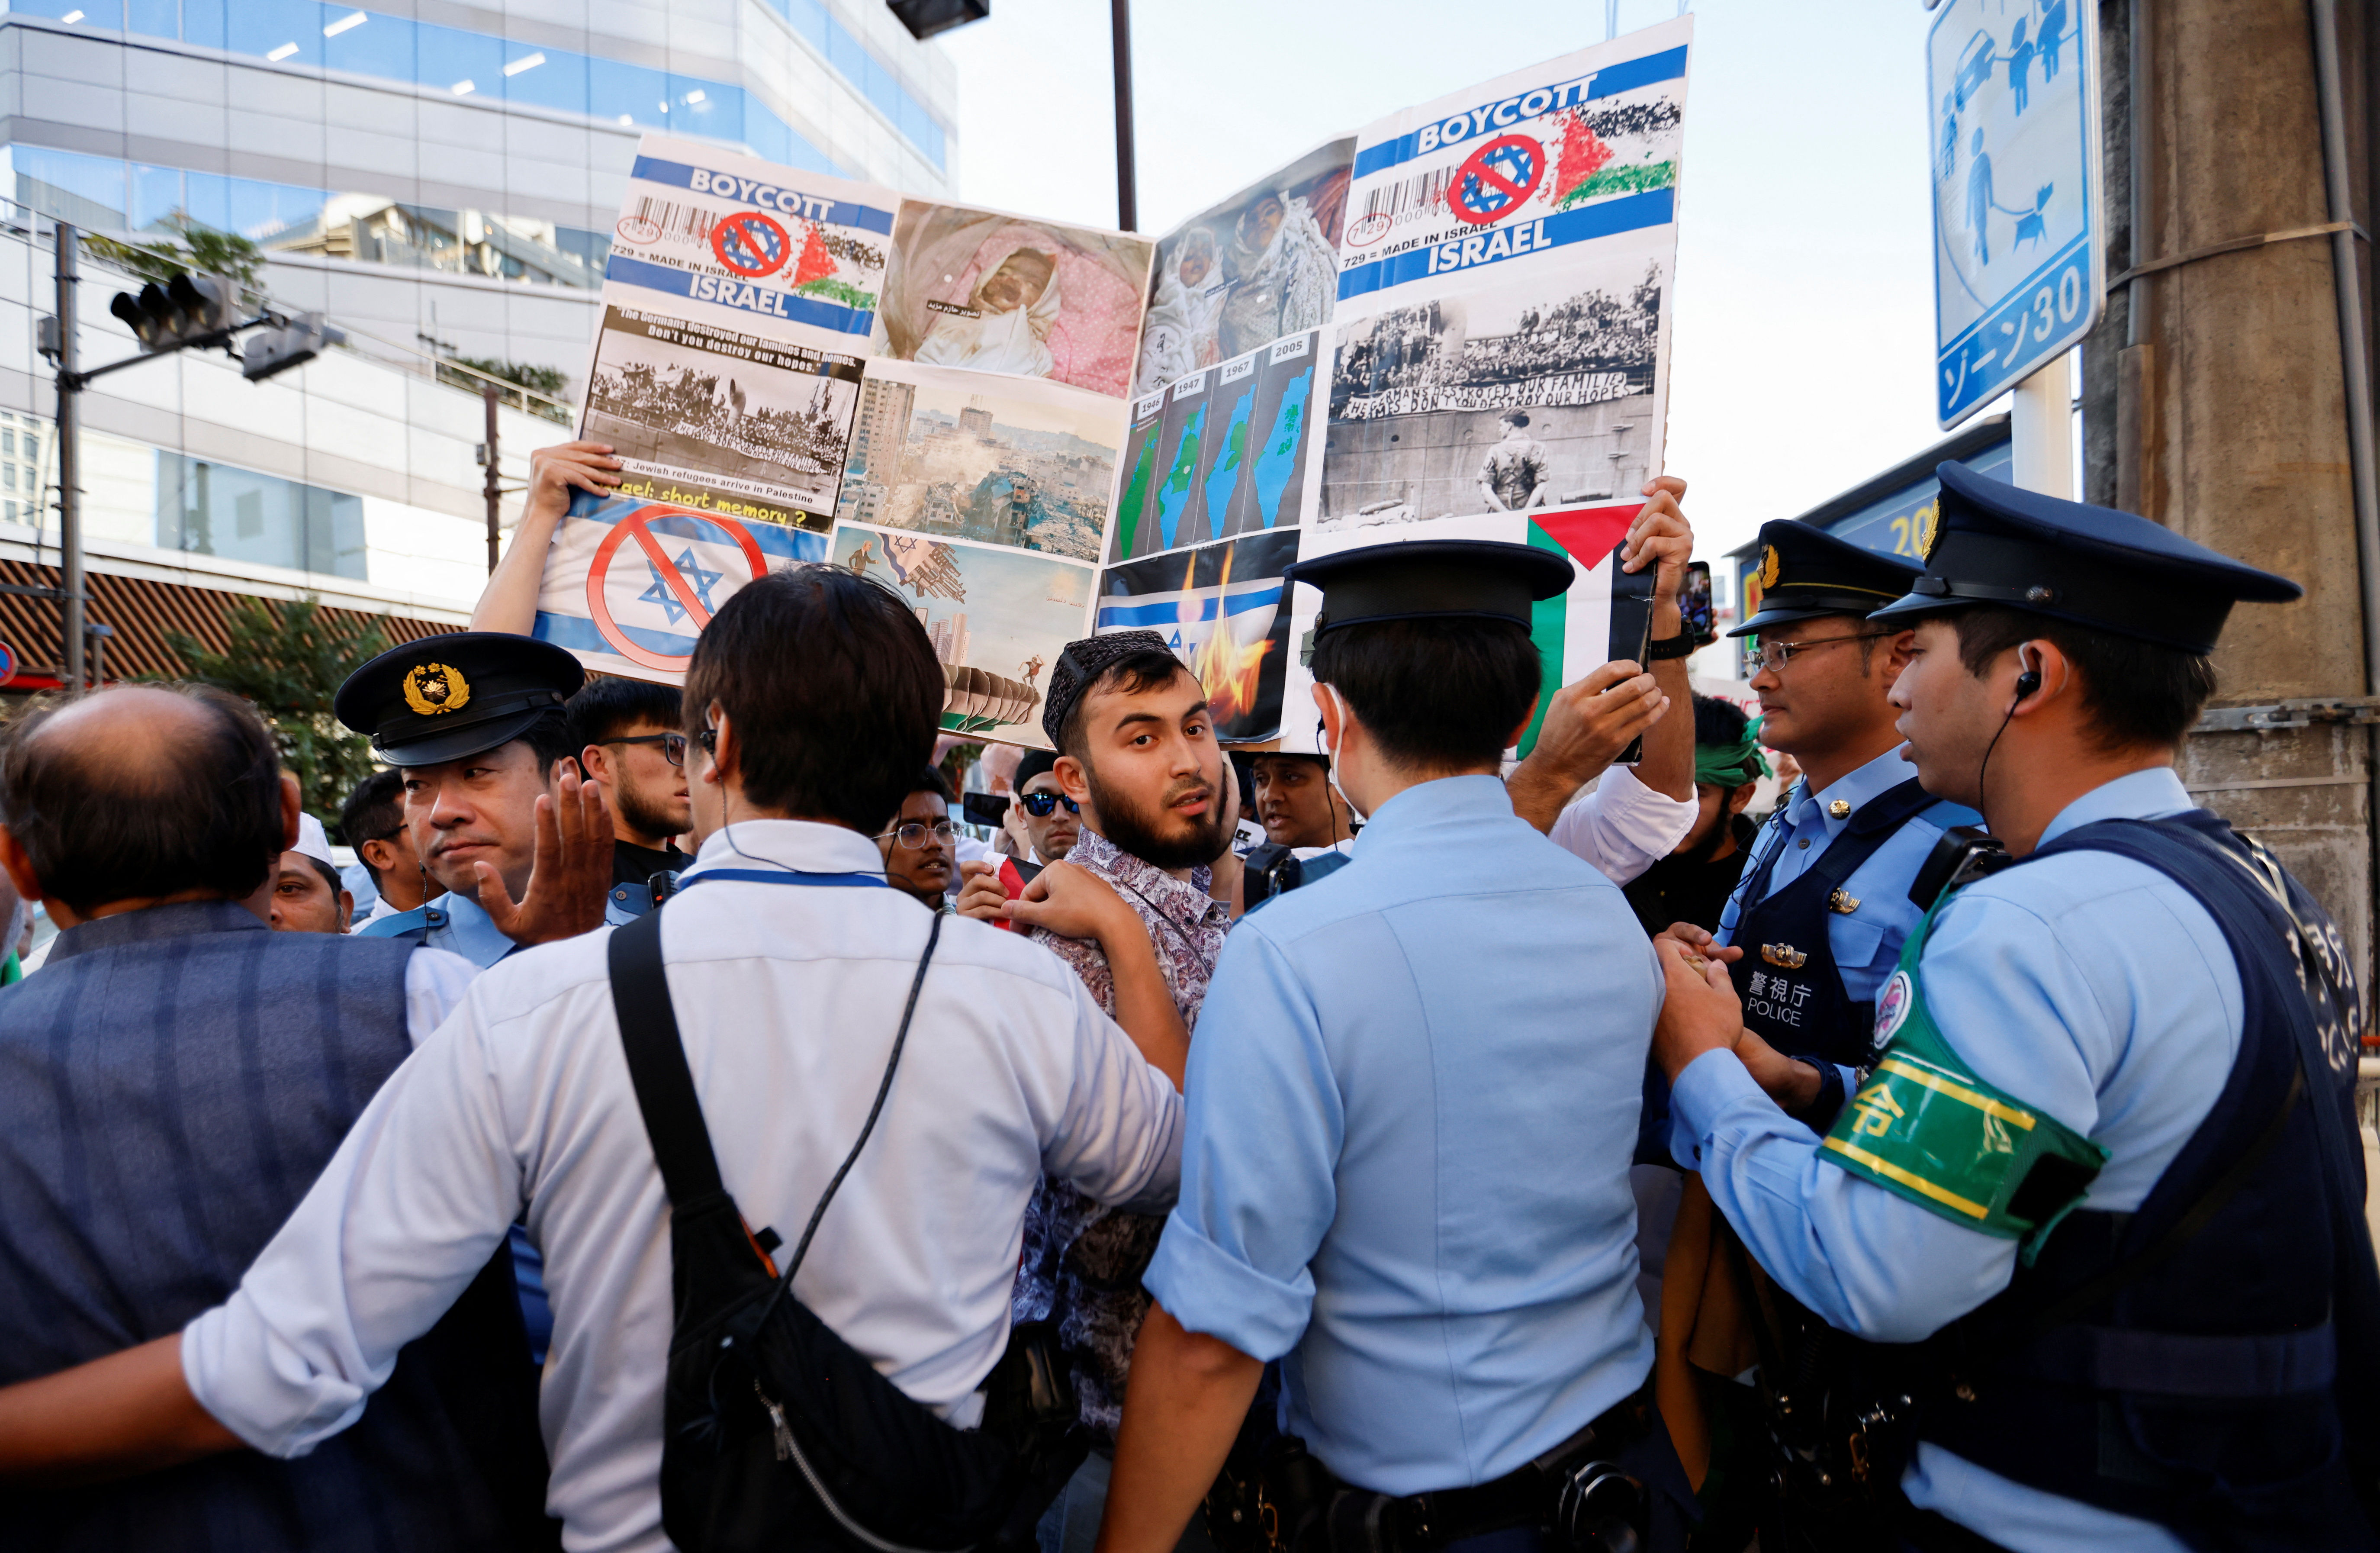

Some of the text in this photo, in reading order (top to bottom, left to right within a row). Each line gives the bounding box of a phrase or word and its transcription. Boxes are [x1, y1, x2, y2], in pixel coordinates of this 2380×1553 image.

[1418, 73, 1598, 155] BOYCOTT
[690, 167, 835, 222] BOYCOTT
[613, 244, 634, 256] 729
[649, 254, 685, 268] MADE
[688, 262, 701, 271] IN
[1344, 254, 1366, 268] 729
[1382, 238, 1419, 258] MADE
[1424, 234, 1439, 244] IN
[1444, 222, 1498, 240] ISRAEL
[1428, 218, 1552, 274] ISRAEL
[689, 274, 788, 318] ISRAEL
[640, 312, 686, 331] Germans
[687, 322, 740, 343] destroyed
[740, 334, 757, 348] our
[758, 338, 800, 357] families
[801, 347, 821, 361] and
[821, 352, 856, 368] homes.
[648, 325, 679, 342] Don't
[681, 333, 704, 347] you
[706, 338, 751, 359] destroy
[754, 350, 775, 363] our
[1275, 341, 1303, 358] 2005
[1945, 265, 2081, 409] ゾーン30
[1177, 378, 1200, 394] 1947
[1226, 361, 1250, 378] 1967
[1518, 377, 1546, 393] OUR
[1142, 398, 1160, 413] 1946
[1546, 392, 1572, 406] OUR
[633, 463, 813, 504] Jewish refugees arrive in Palestine
[660, 486, 711, 509] short
[716, 500, 787, 525] memory
[795, 510, 807, 527] ?
[1749, 970, 1812, 1008] 警視庁
[1747, 997, 1802, 1027] POLICE
